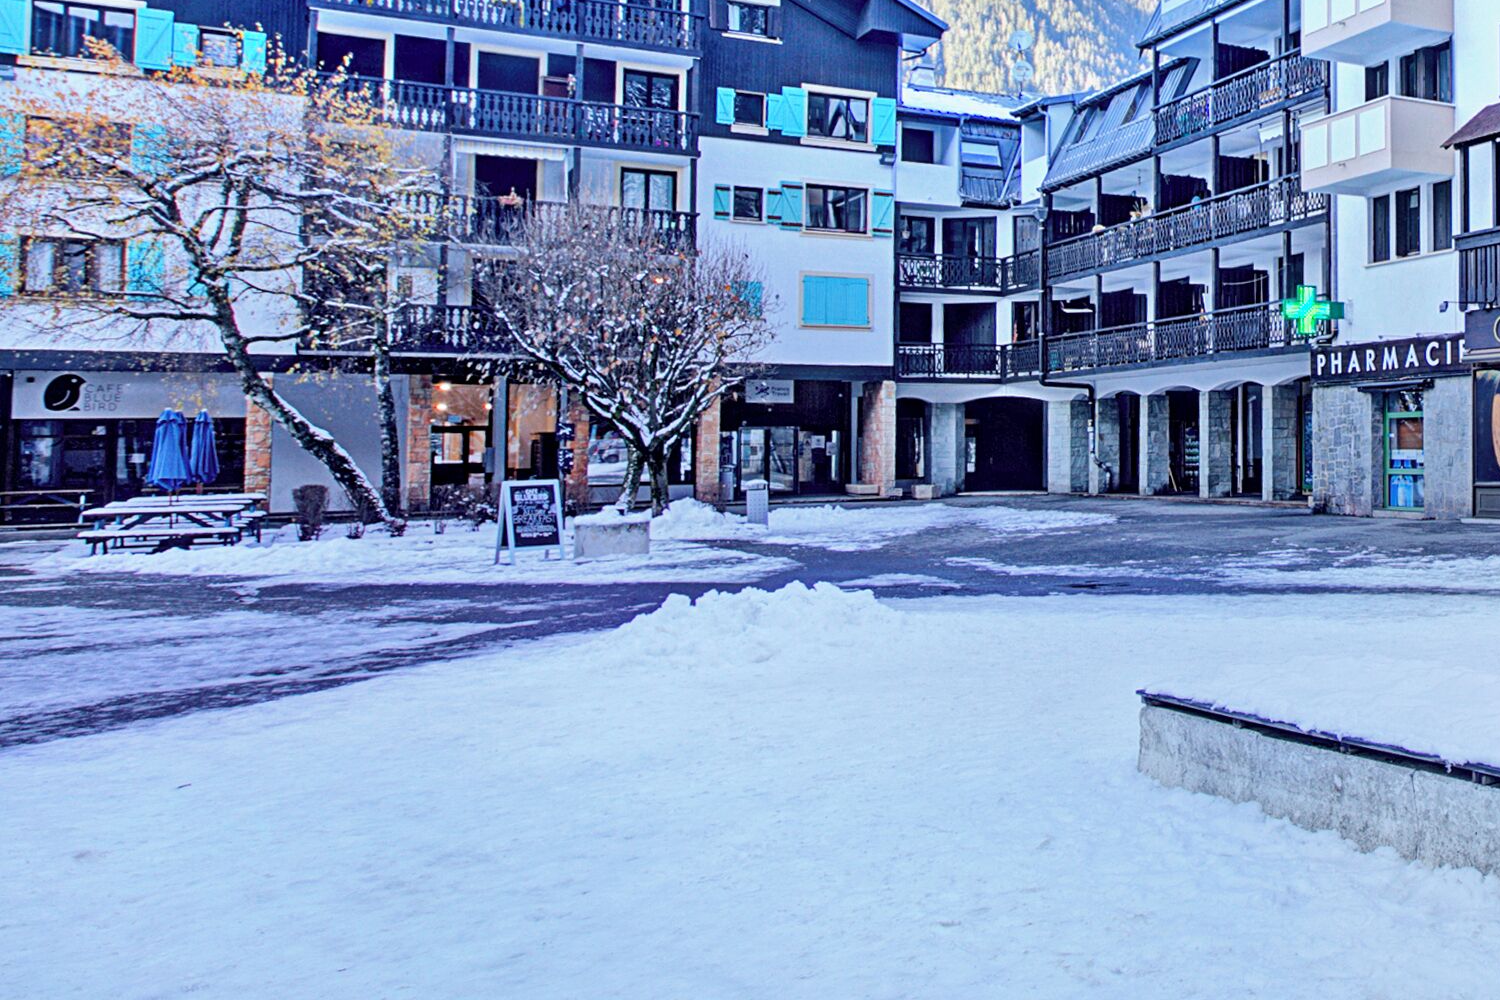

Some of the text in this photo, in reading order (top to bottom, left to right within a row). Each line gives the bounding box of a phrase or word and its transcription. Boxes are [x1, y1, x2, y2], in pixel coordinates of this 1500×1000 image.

[84, 383, 123, 394] CAFE
[84, 392, 121, 403] BLUE
[83, 402, 117, 412] BIRD
